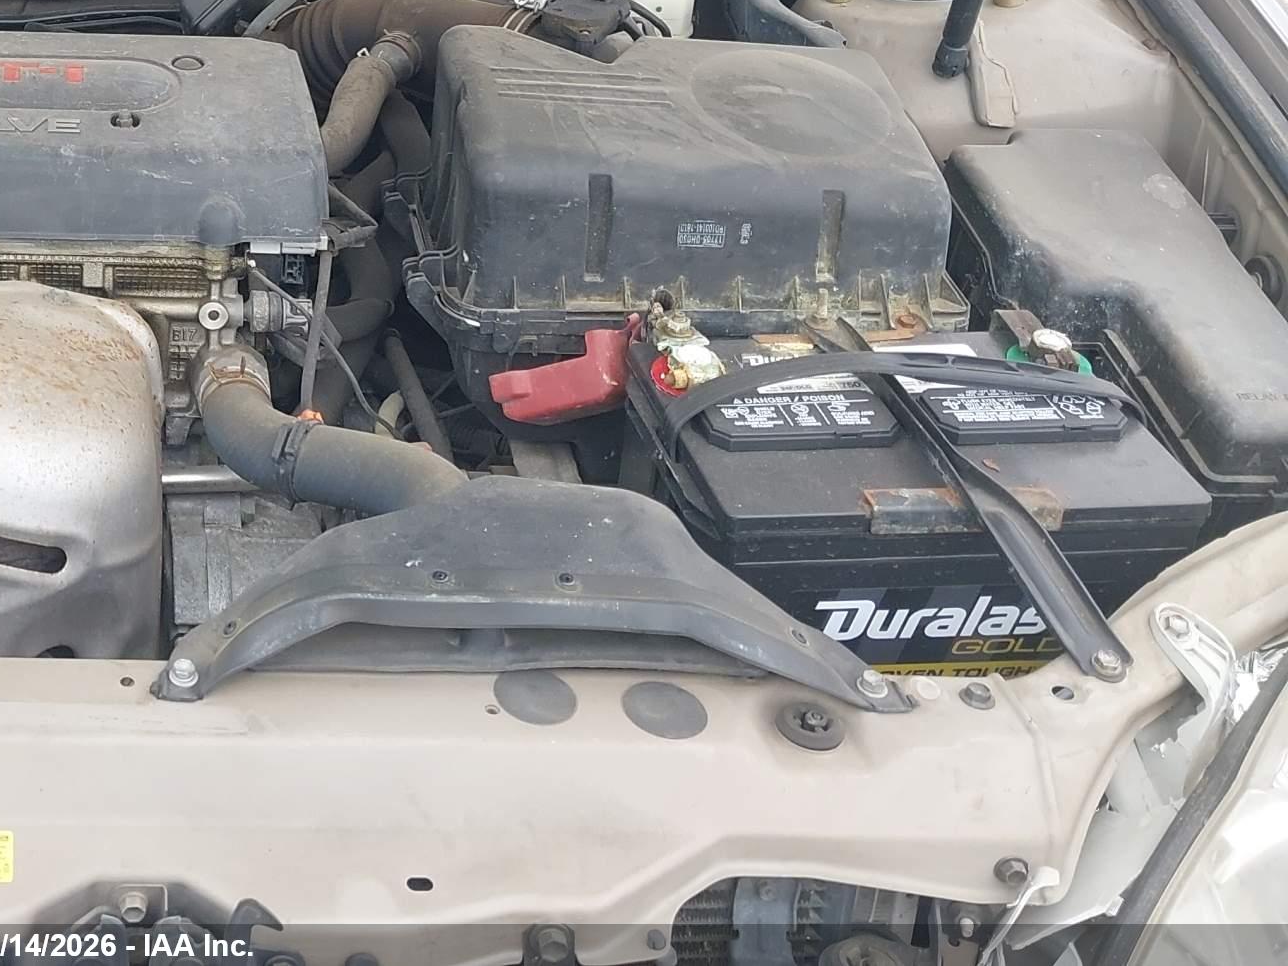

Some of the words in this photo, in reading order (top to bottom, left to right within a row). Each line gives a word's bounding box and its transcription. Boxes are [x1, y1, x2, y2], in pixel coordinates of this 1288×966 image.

[744, 396, 792, 404] DANGER
[815, 595, 1047, 641] Duralas
[951, 637, 1065, 655] GOLD
